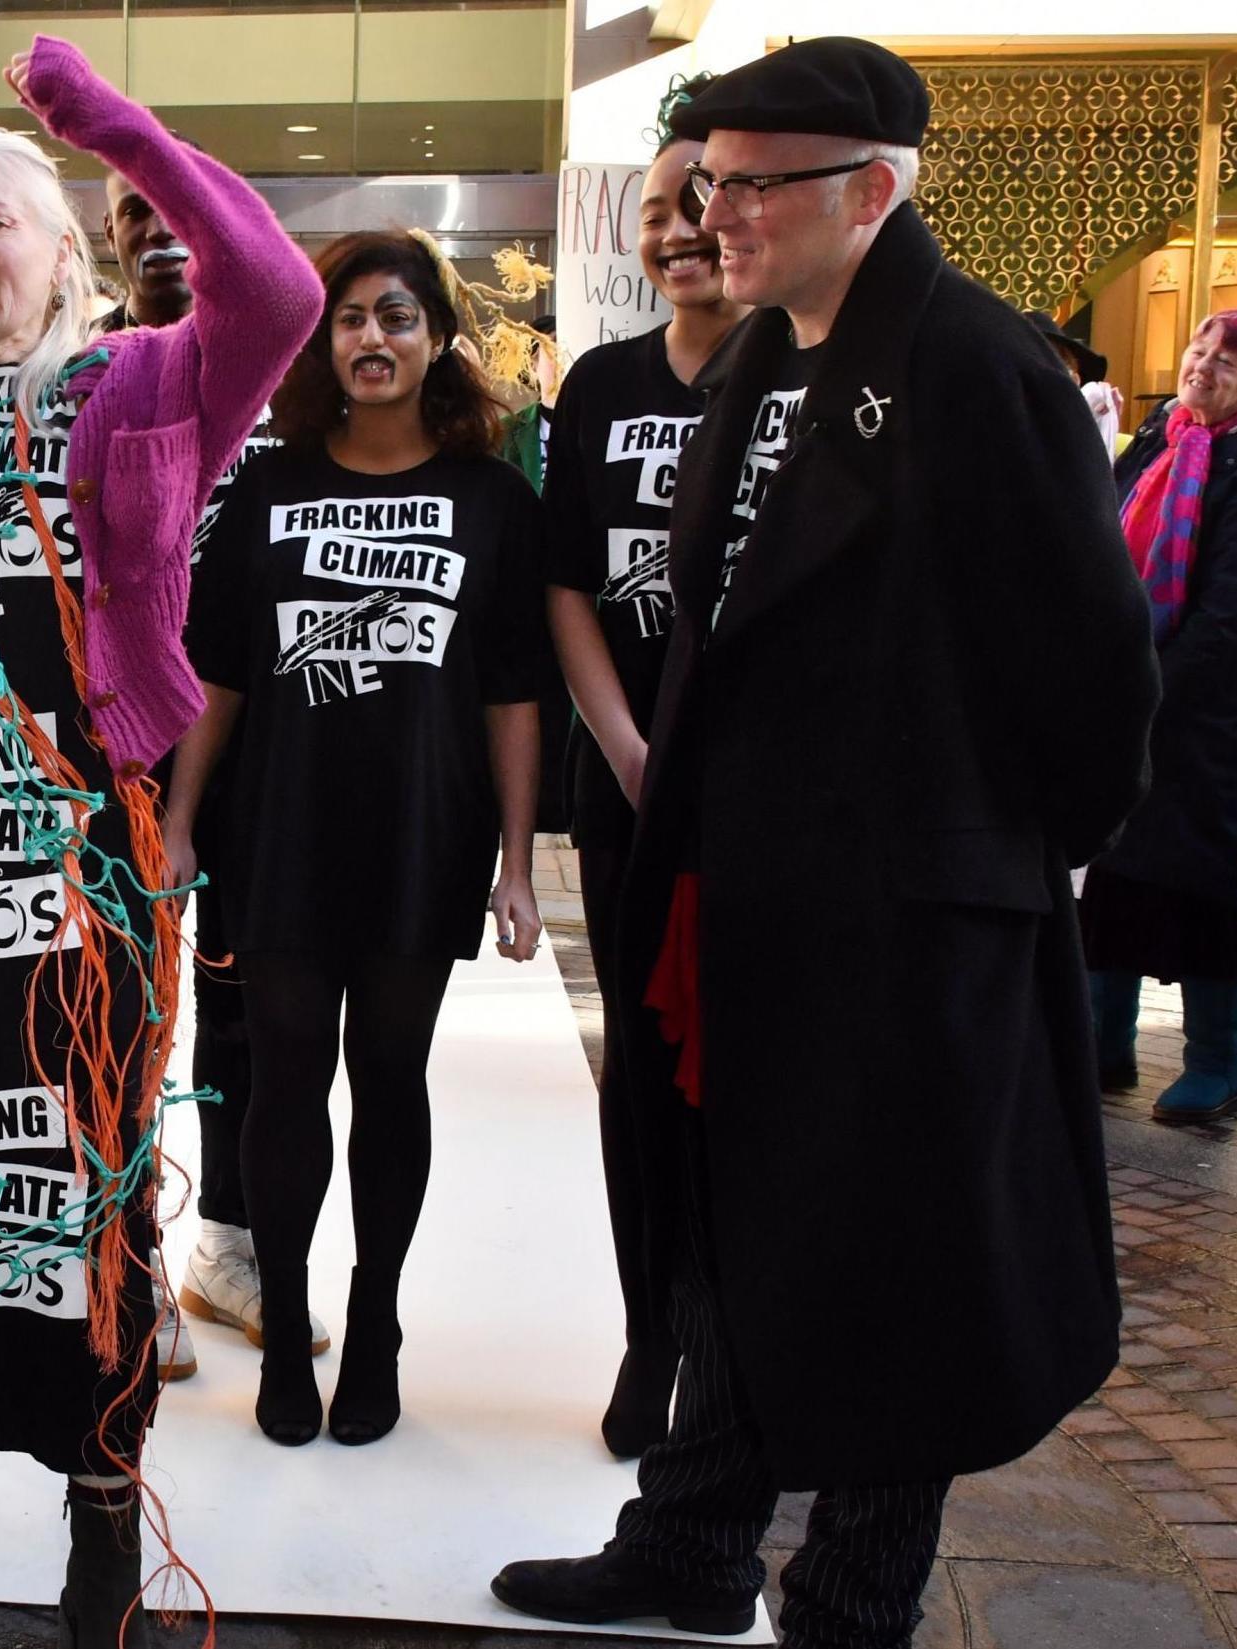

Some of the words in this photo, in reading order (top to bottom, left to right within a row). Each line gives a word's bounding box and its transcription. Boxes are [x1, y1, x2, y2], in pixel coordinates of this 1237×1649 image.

[563, 167, 643, 256] FRAC
[583, 263, 658, 313] Won
[284, 501, 441, 533] FRACKING
[319, 540, 452, 588] CLIMATE
[295, 608, 437, 655] CHAOS
[302, 656, 384, 708] INE
